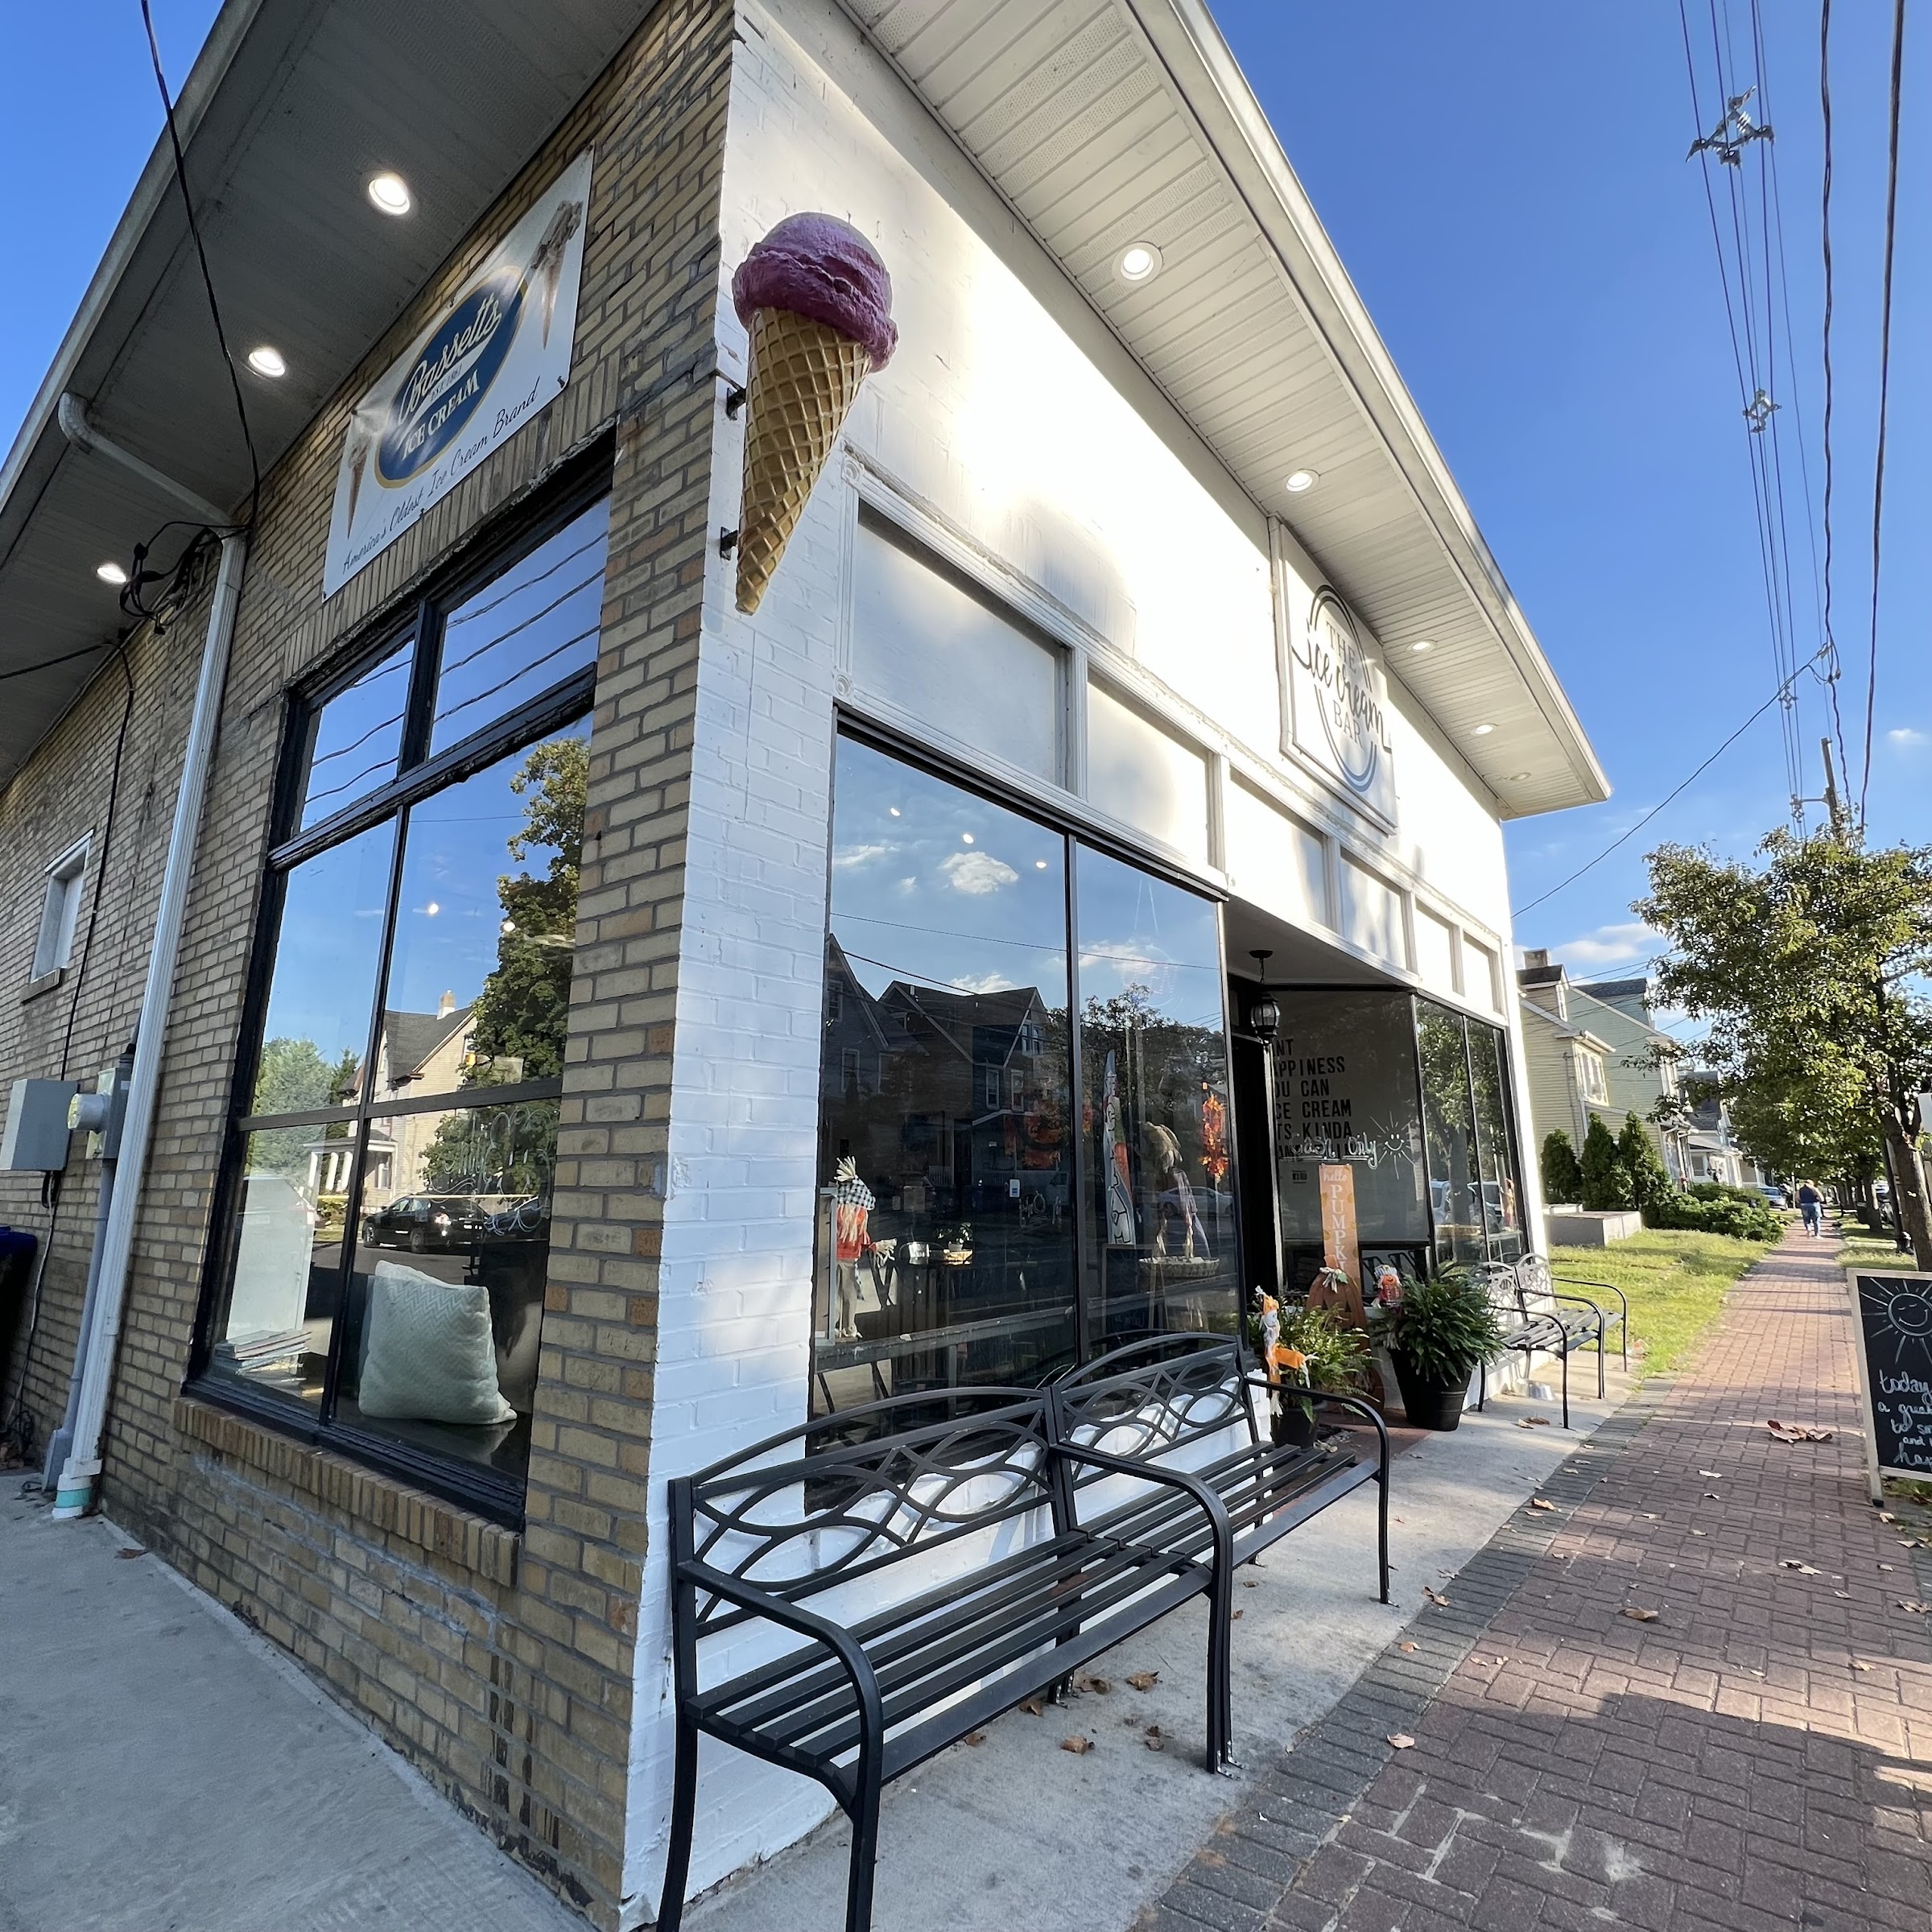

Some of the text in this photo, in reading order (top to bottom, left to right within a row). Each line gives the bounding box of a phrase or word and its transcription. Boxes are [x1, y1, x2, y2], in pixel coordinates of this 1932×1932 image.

[398, 292, 502, 426] Bassetts
[402, 369, 481, 460] ICE CREAM
[342, 375, 541, 575] America's Oldest Ice Cream Brand
[1326, 621, 1356, 674] THE
[1333, 700, 1364, 749] BAR
[1301, 1079, 1330, 1096] CAN
[1302, 1099, 1352, 1118] CREAM
[1302, 1121, 1352, 1139] KINDA
[1323, 1167, 1348, 1182] hello
[1877, 1402, 1890, 1412] a
[1903, 1436, 1926, 1446] and
